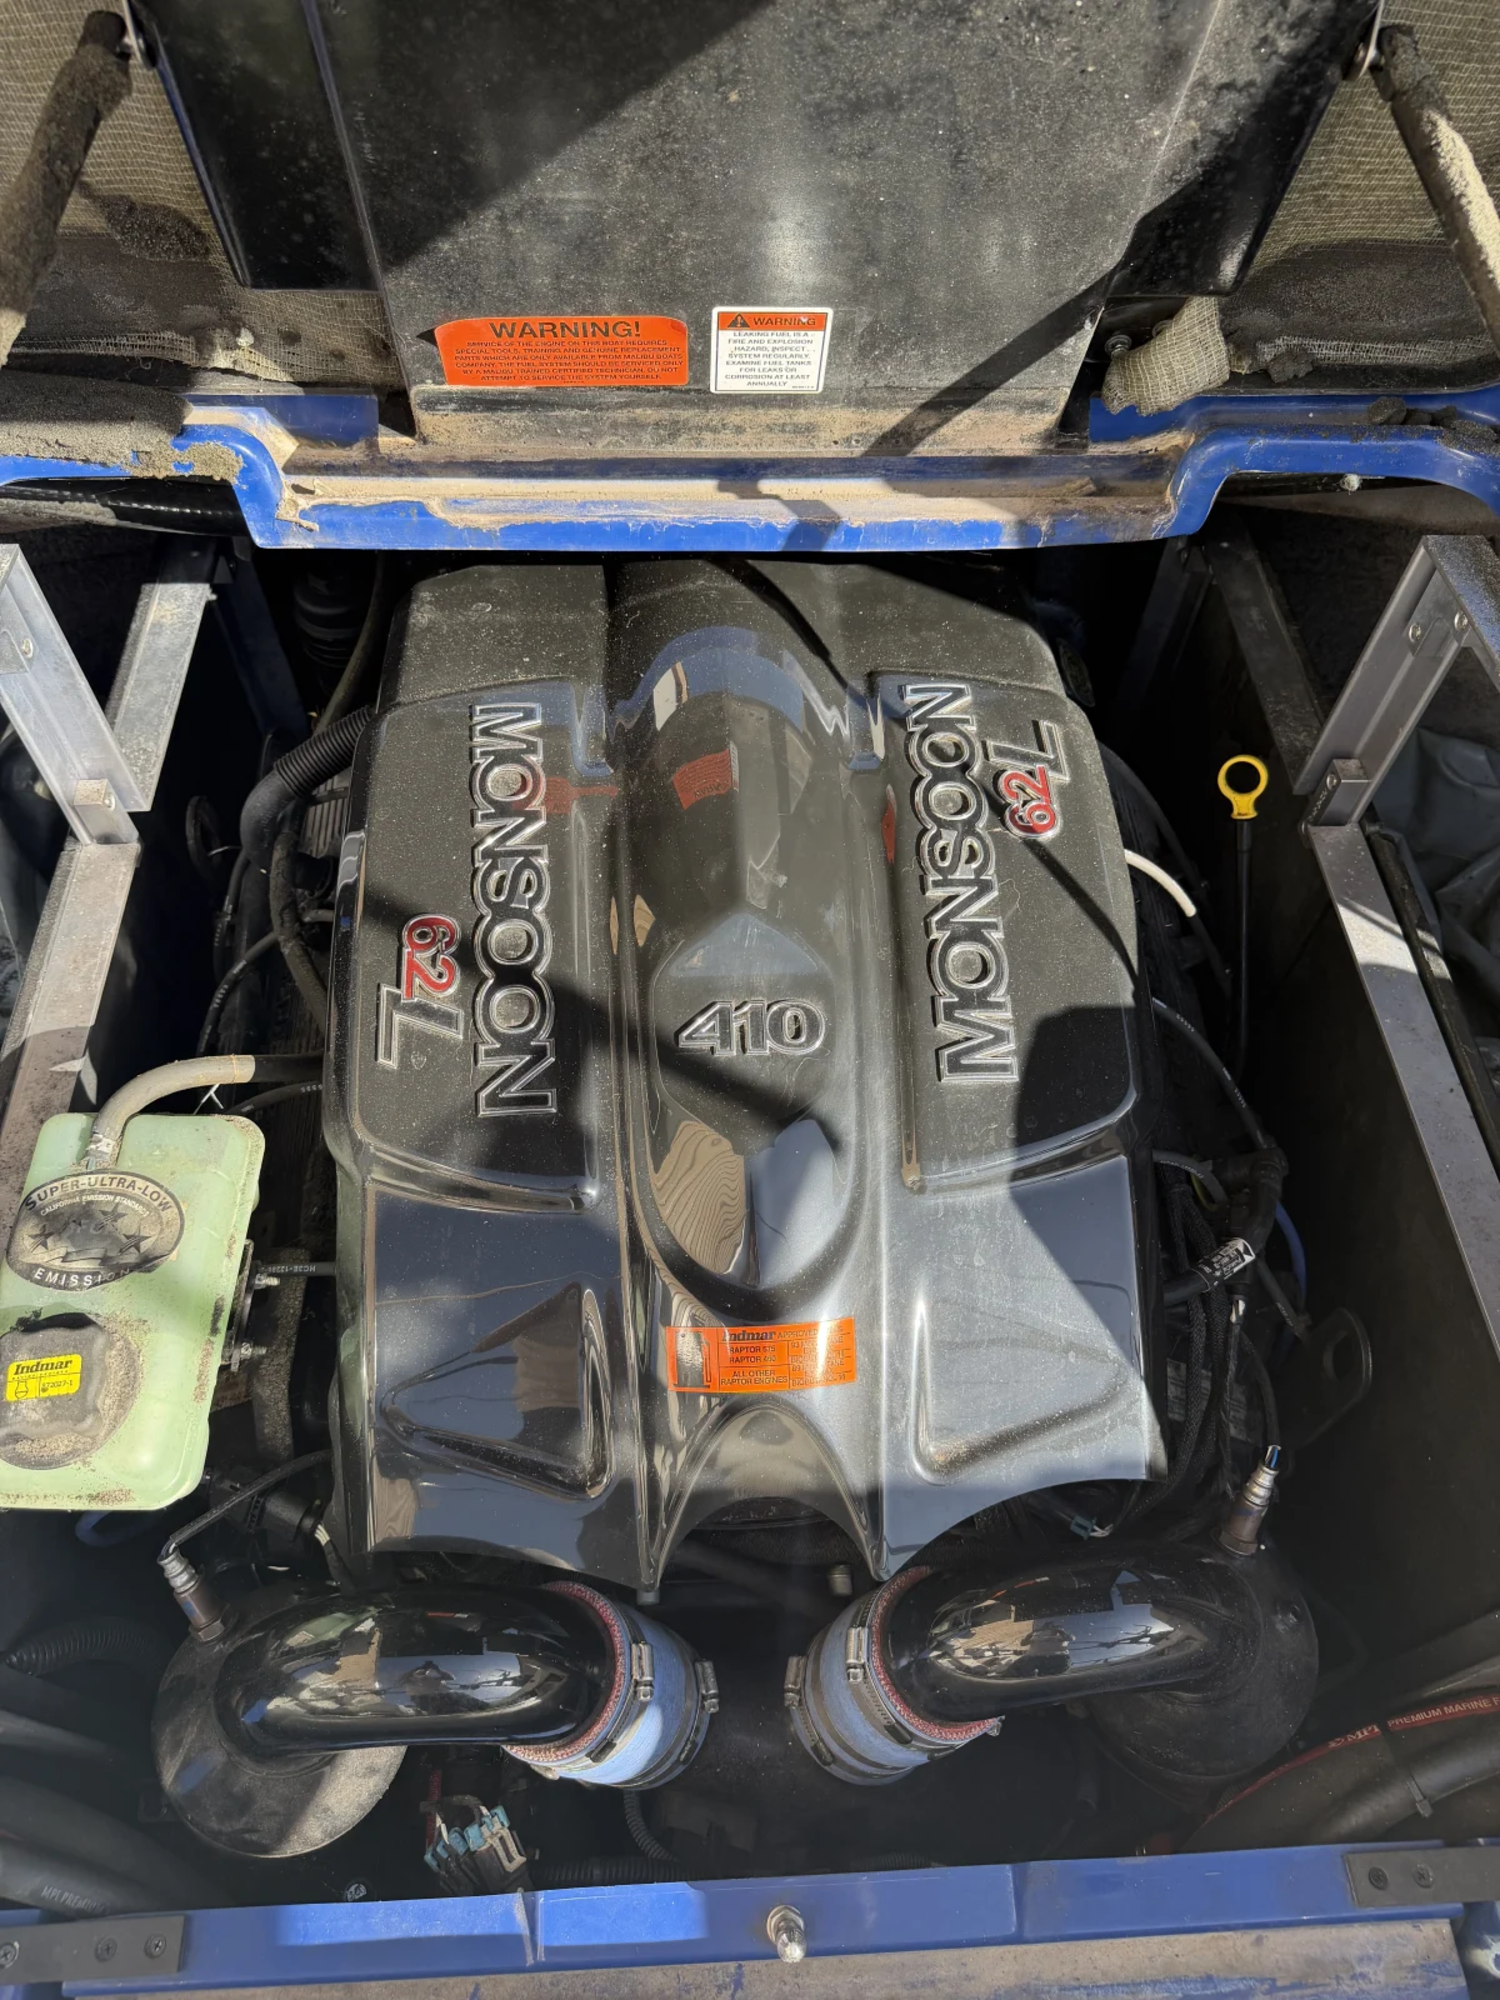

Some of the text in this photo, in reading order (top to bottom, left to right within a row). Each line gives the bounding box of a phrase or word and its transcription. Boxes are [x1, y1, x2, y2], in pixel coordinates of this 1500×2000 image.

[489, 320, 640, 339] WARNING!
[753, 317, 816, 326] WARNING
[904, 684, 1019, 1083] MONSOON
[471, 702, 558, 1118] MONSOON
[677, 1000, 826, 1056] 410
[24, 1175, 173, 1212] SUPER-ULTRA-LOW
[722, 1330, 776, 1341] Indmar
[730, 1346, 761, 1354] RAPTOR
[730, 1355, 761, 1364] RAPTOR
[14, 1360, 73, 1375] Indmar
[720, 1378, 752, 1386] RAPTOR
[754, 1375, 788, 1385] ENGINES
[1347, 1723, 1381, 1741] MPI
[1387, 1708, 1443, 1728] PREMIUM
[1444, 1697, 1492, 1715] MARINE
[40, 1884, 105, 1914] MPI PREMIUM
